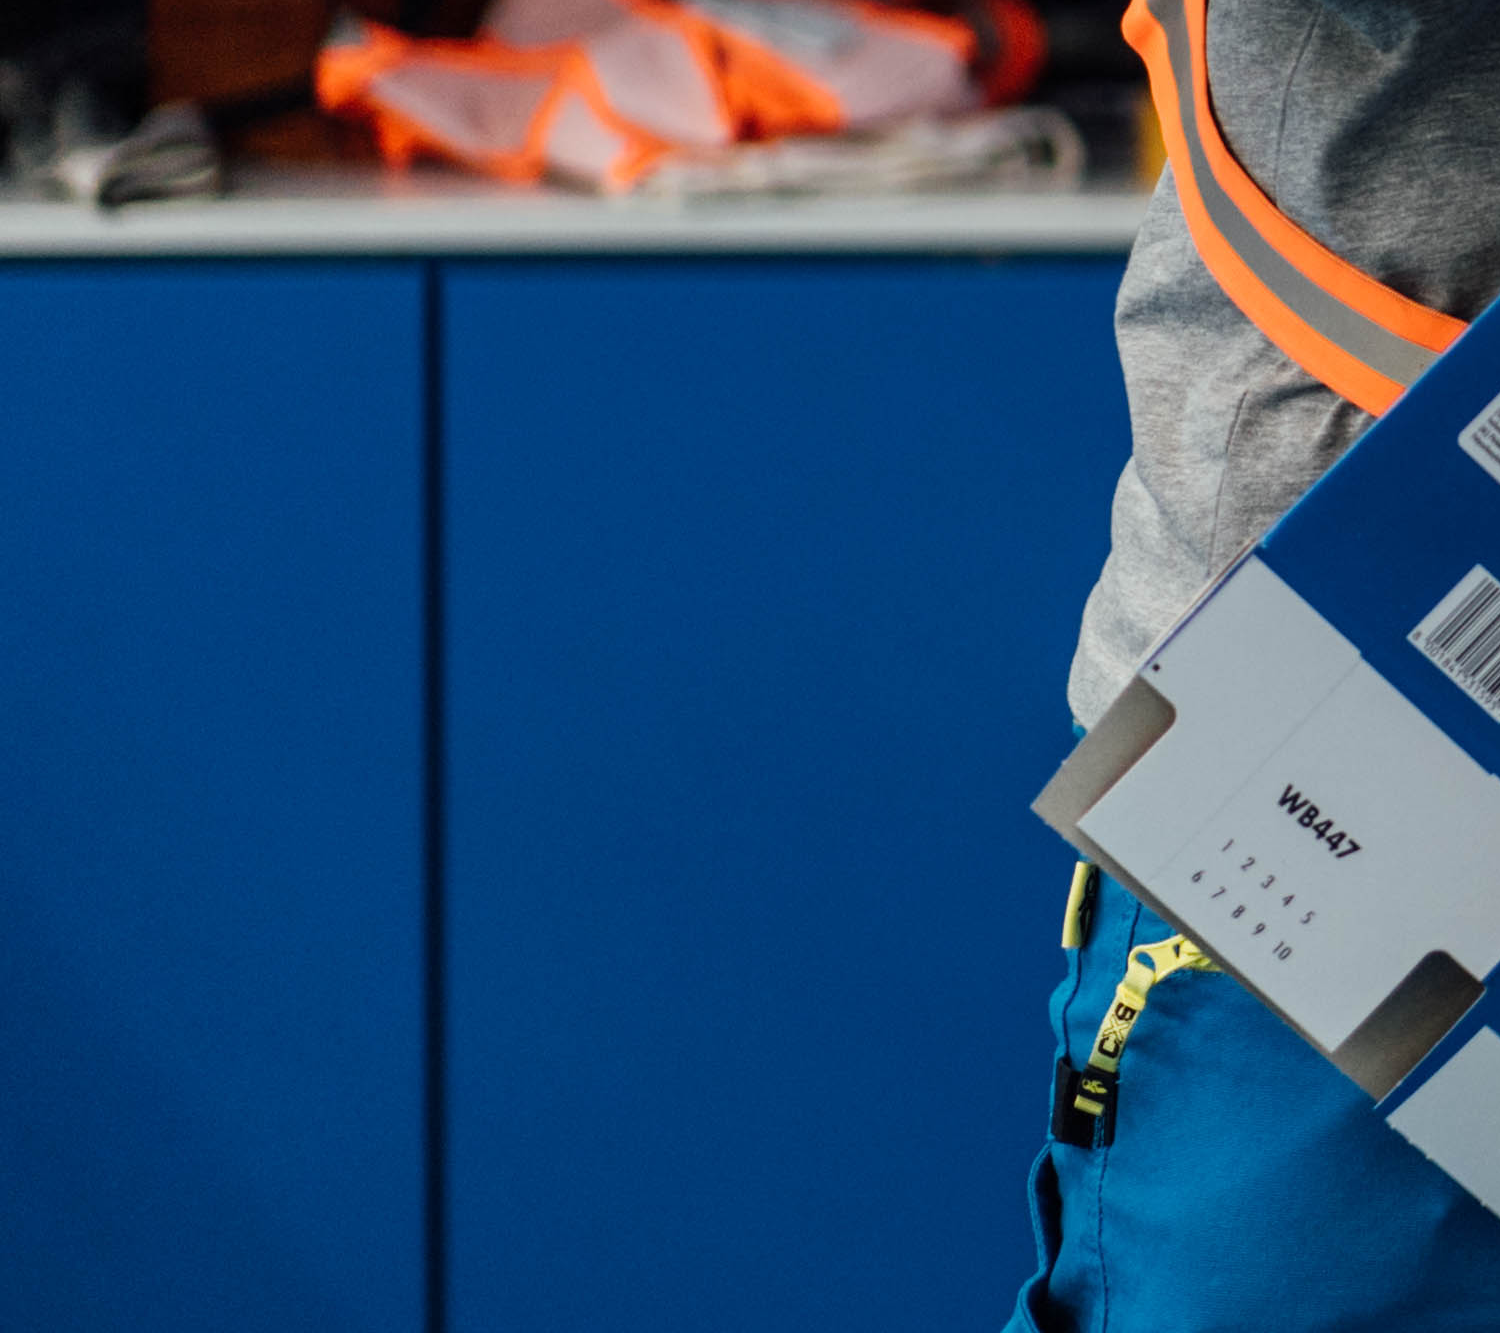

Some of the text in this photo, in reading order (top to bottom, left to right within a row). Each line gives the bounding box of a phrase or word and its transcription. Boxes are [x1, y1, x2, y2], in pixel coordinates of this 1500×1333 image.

[1278, 784, 1361, 858] WB447
[1191, 870, 1292, 961] 6 7 8 9 10
[1221, 838, 1315, 925] 1 2 3 4 5
